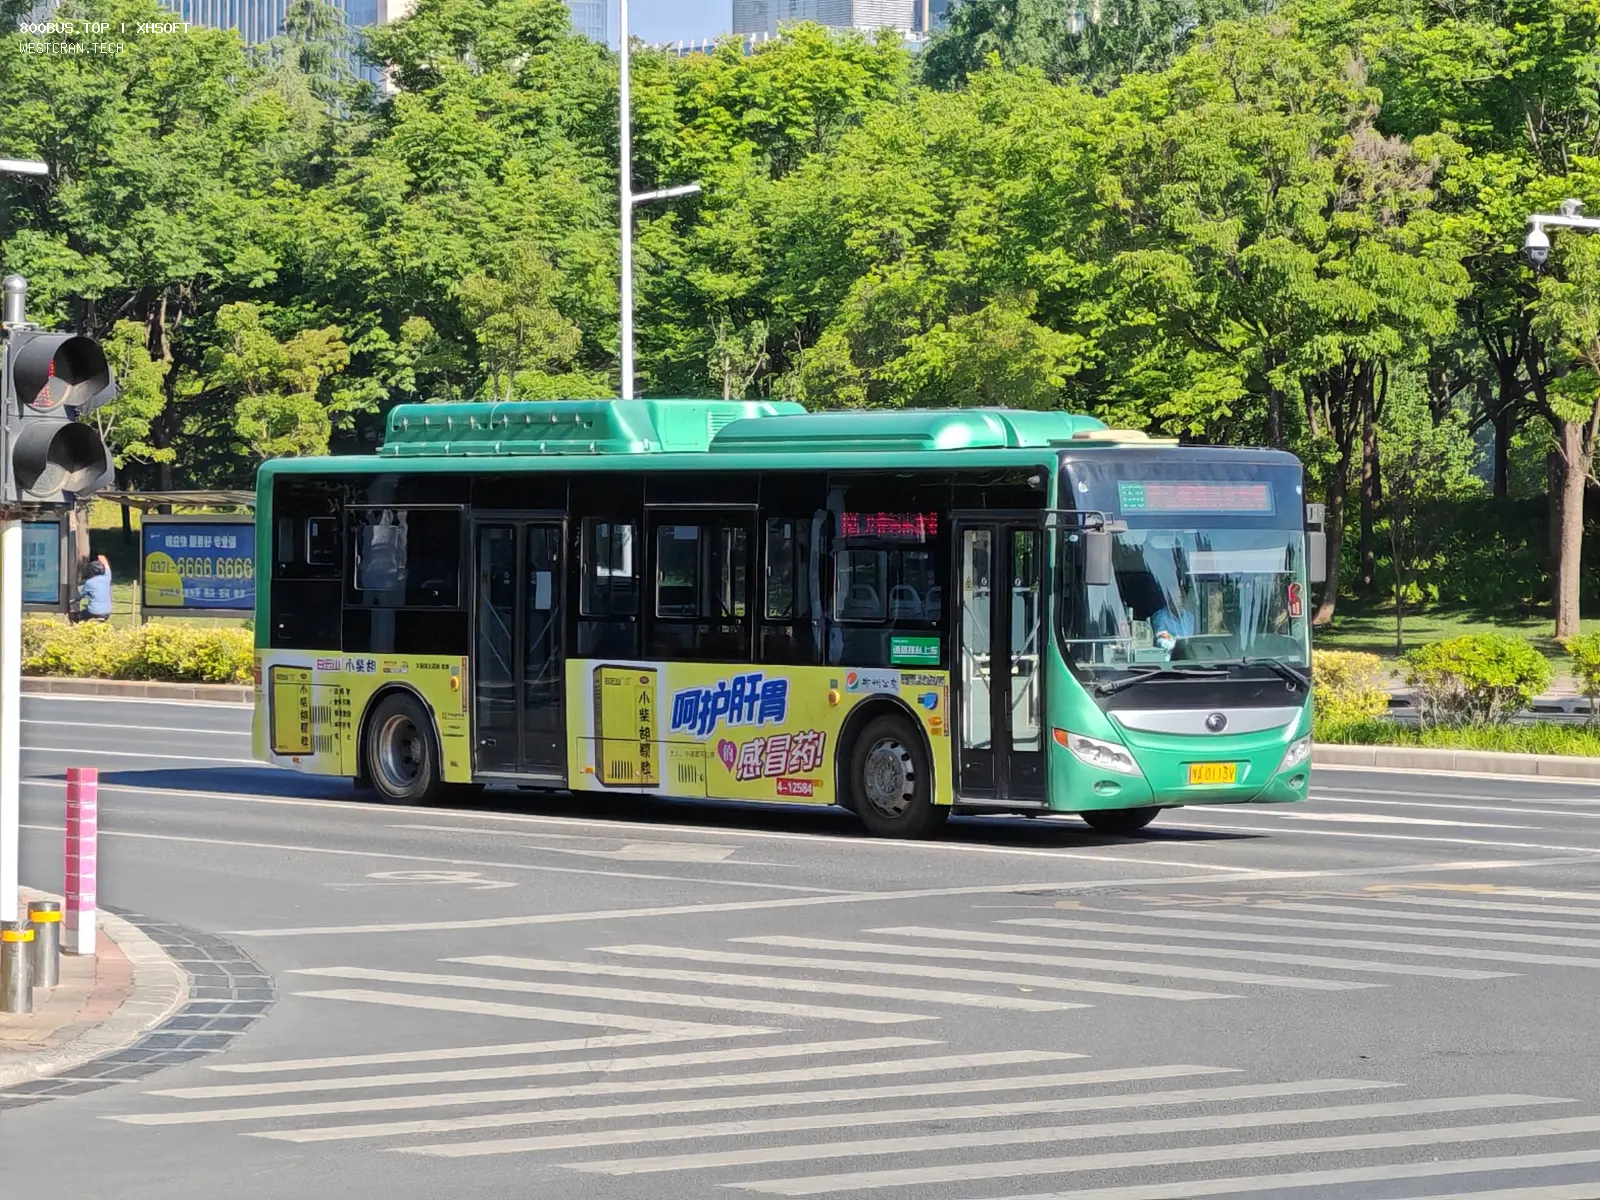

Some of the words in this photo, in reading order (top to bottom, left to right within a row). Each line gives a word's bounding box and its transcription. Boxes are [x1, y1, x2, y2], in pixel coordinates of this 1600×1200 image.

[670, 672, 789, 736] 呵护肝胃
[736, 729, 827, 782] 感冒药!
[776, 778, 814, 795] 4-12584
